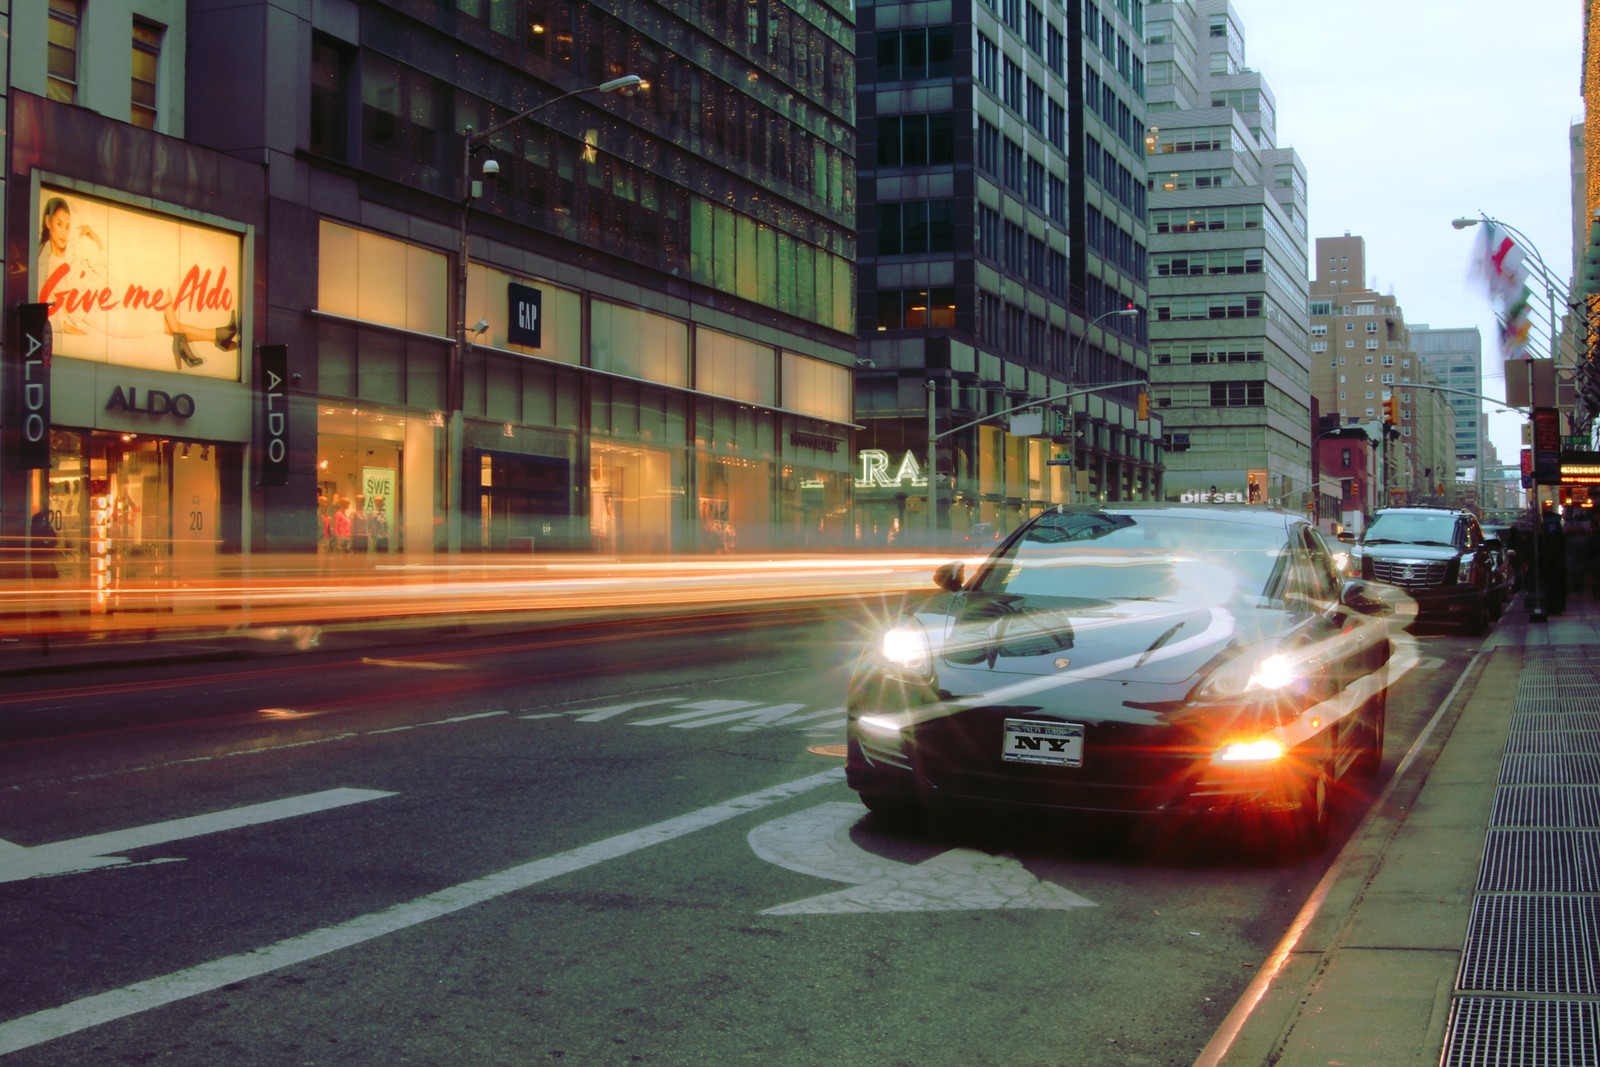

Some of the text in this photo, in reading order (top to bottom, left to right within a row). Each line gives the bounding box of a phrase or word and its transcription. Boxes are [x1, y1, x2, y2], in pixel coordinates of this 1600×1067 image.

[38, 263, 232, 317] Give me Aldo
[518, 301, 537, 332] GAP
[25, 332, 44, 442] ALDO
[106, 385, 195, 419] ALDO
[267, 370, 285, 463] ALDO
[367, 478, 390, 495] SWE
[1180, 492, 1246, 504] DIESEL
[190, 511, 203, 531] 20
[1014, 736, 1070, 753] NY
